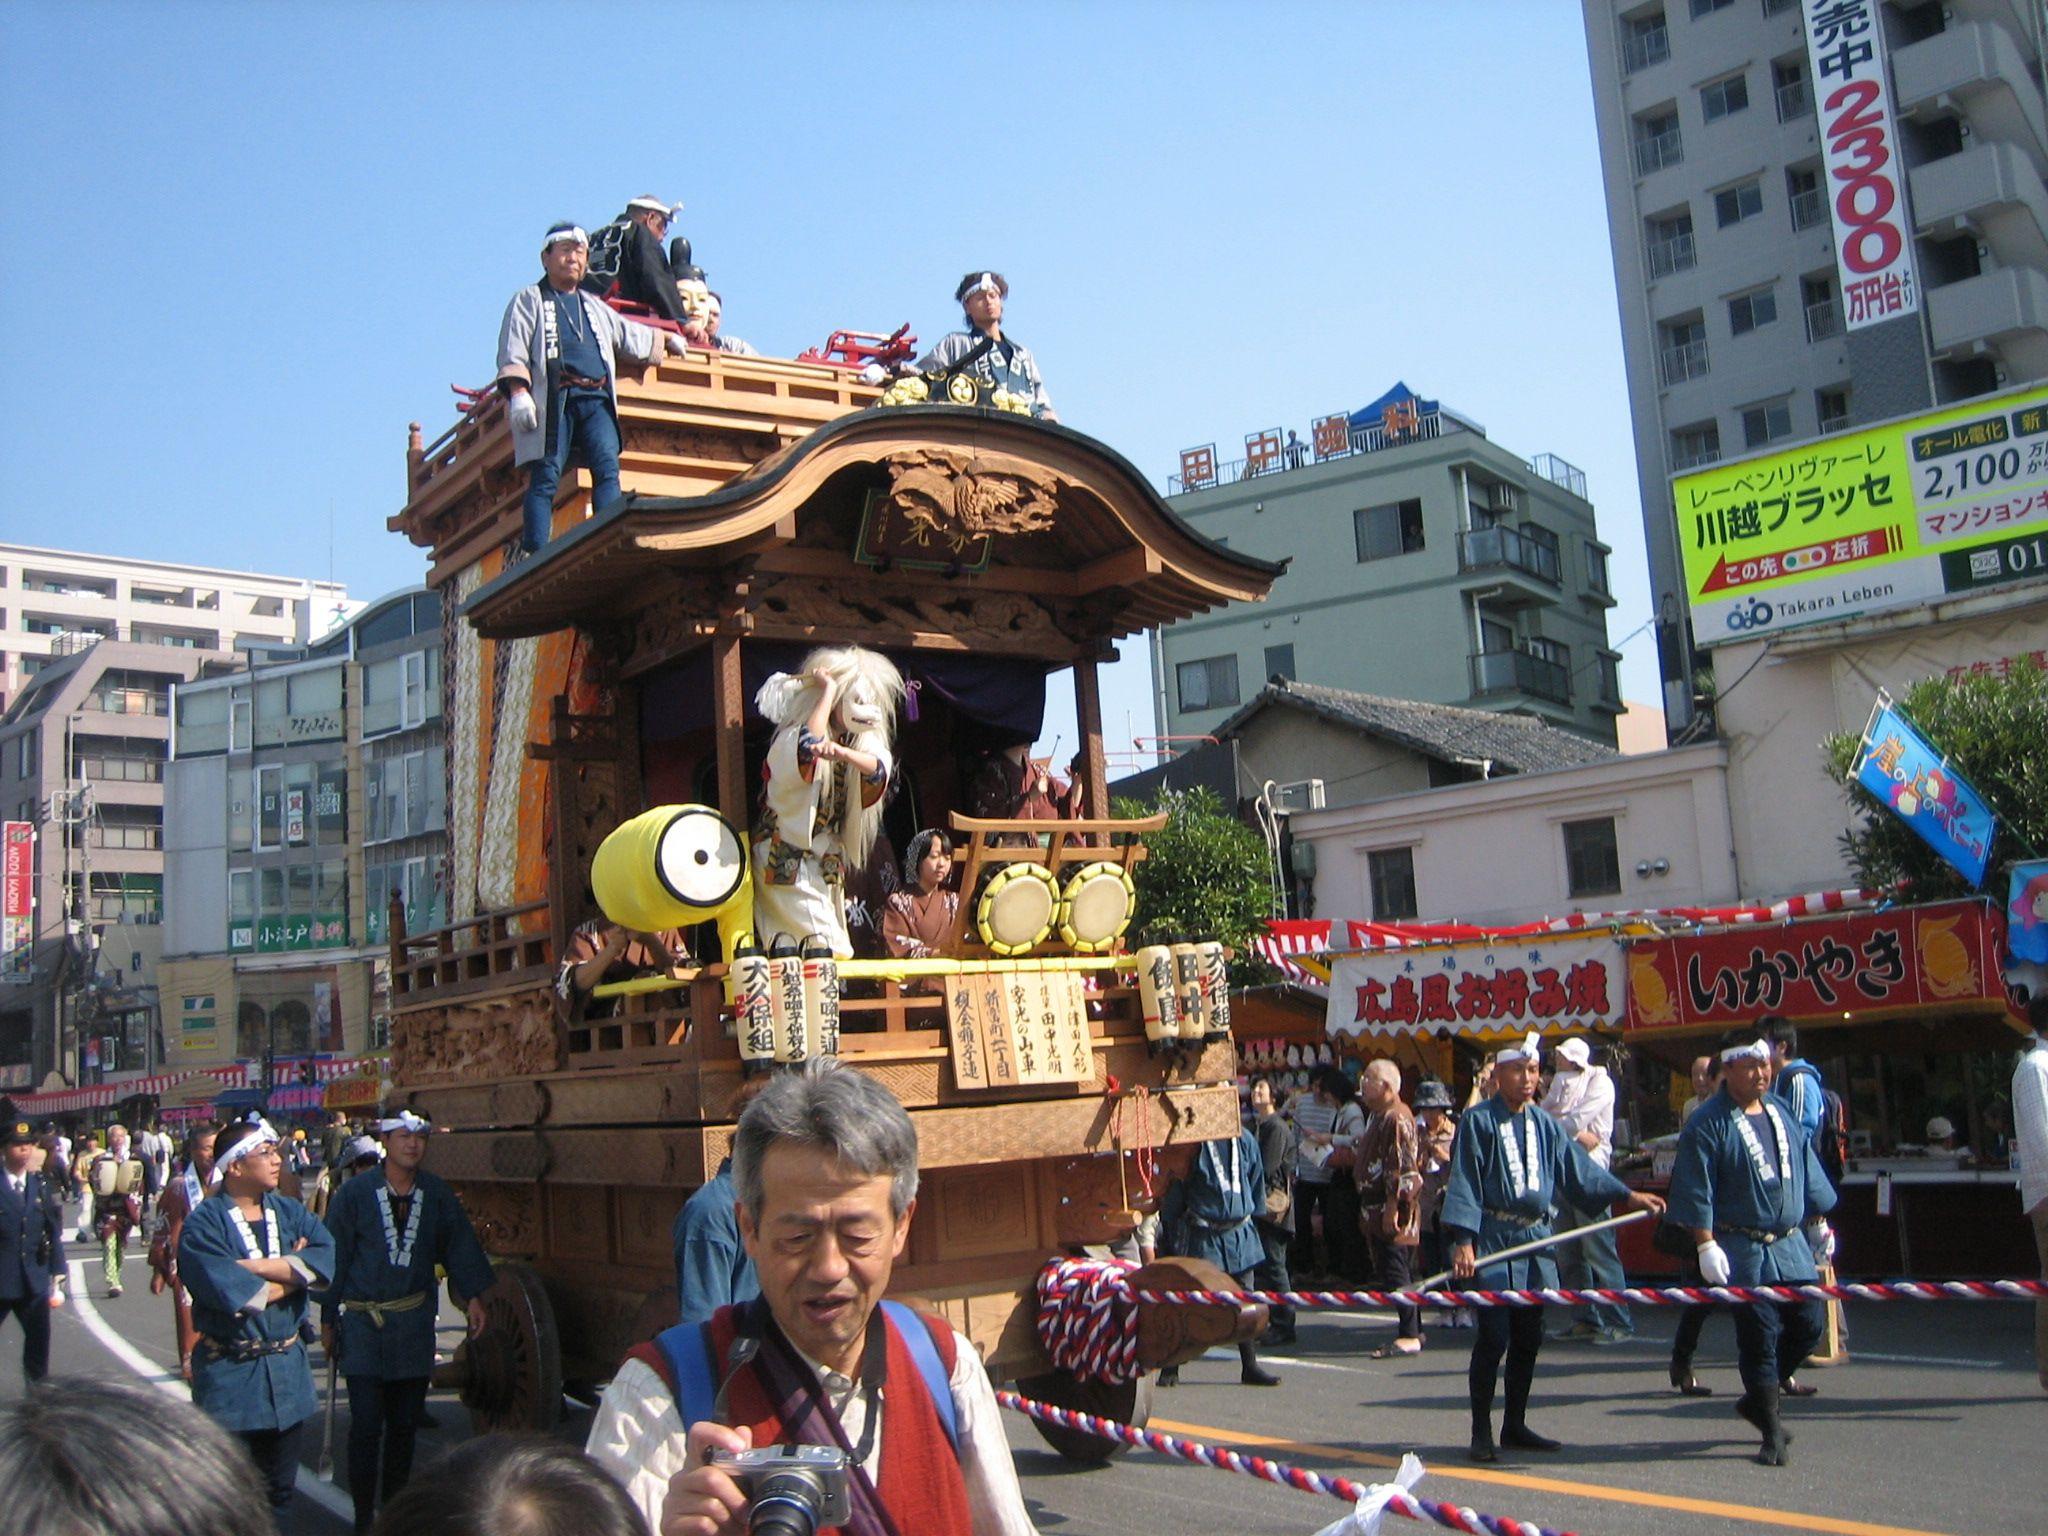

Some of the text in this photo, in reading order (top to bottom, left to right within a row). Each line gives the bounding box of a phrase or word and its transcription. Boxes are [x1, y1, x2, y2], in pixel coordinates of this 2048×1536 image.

[1811, 0, 1874, 81] 売中
[1824, 79, 1903, 274] 2300
[1690, 443, 1886, 509] レーベンリヴァーレ
[1924, 447, 2020, 499] 2,100
[1695, 472, 1893, 550] 川越ブラッセ
[1725, 535, 1869, 585] この先 左折
[1777, 583, 1894, 617] Takara Leben
[742, 960, 775, 1054] 大久保組
[1177, 953, 1204, 1025] 田中
[1204, 946, 1231, 1029] 大久保組
[1354, 958, 1611, 1025] 広島風お好み焼
[1686, 928, 1905, 1014] いかやき
